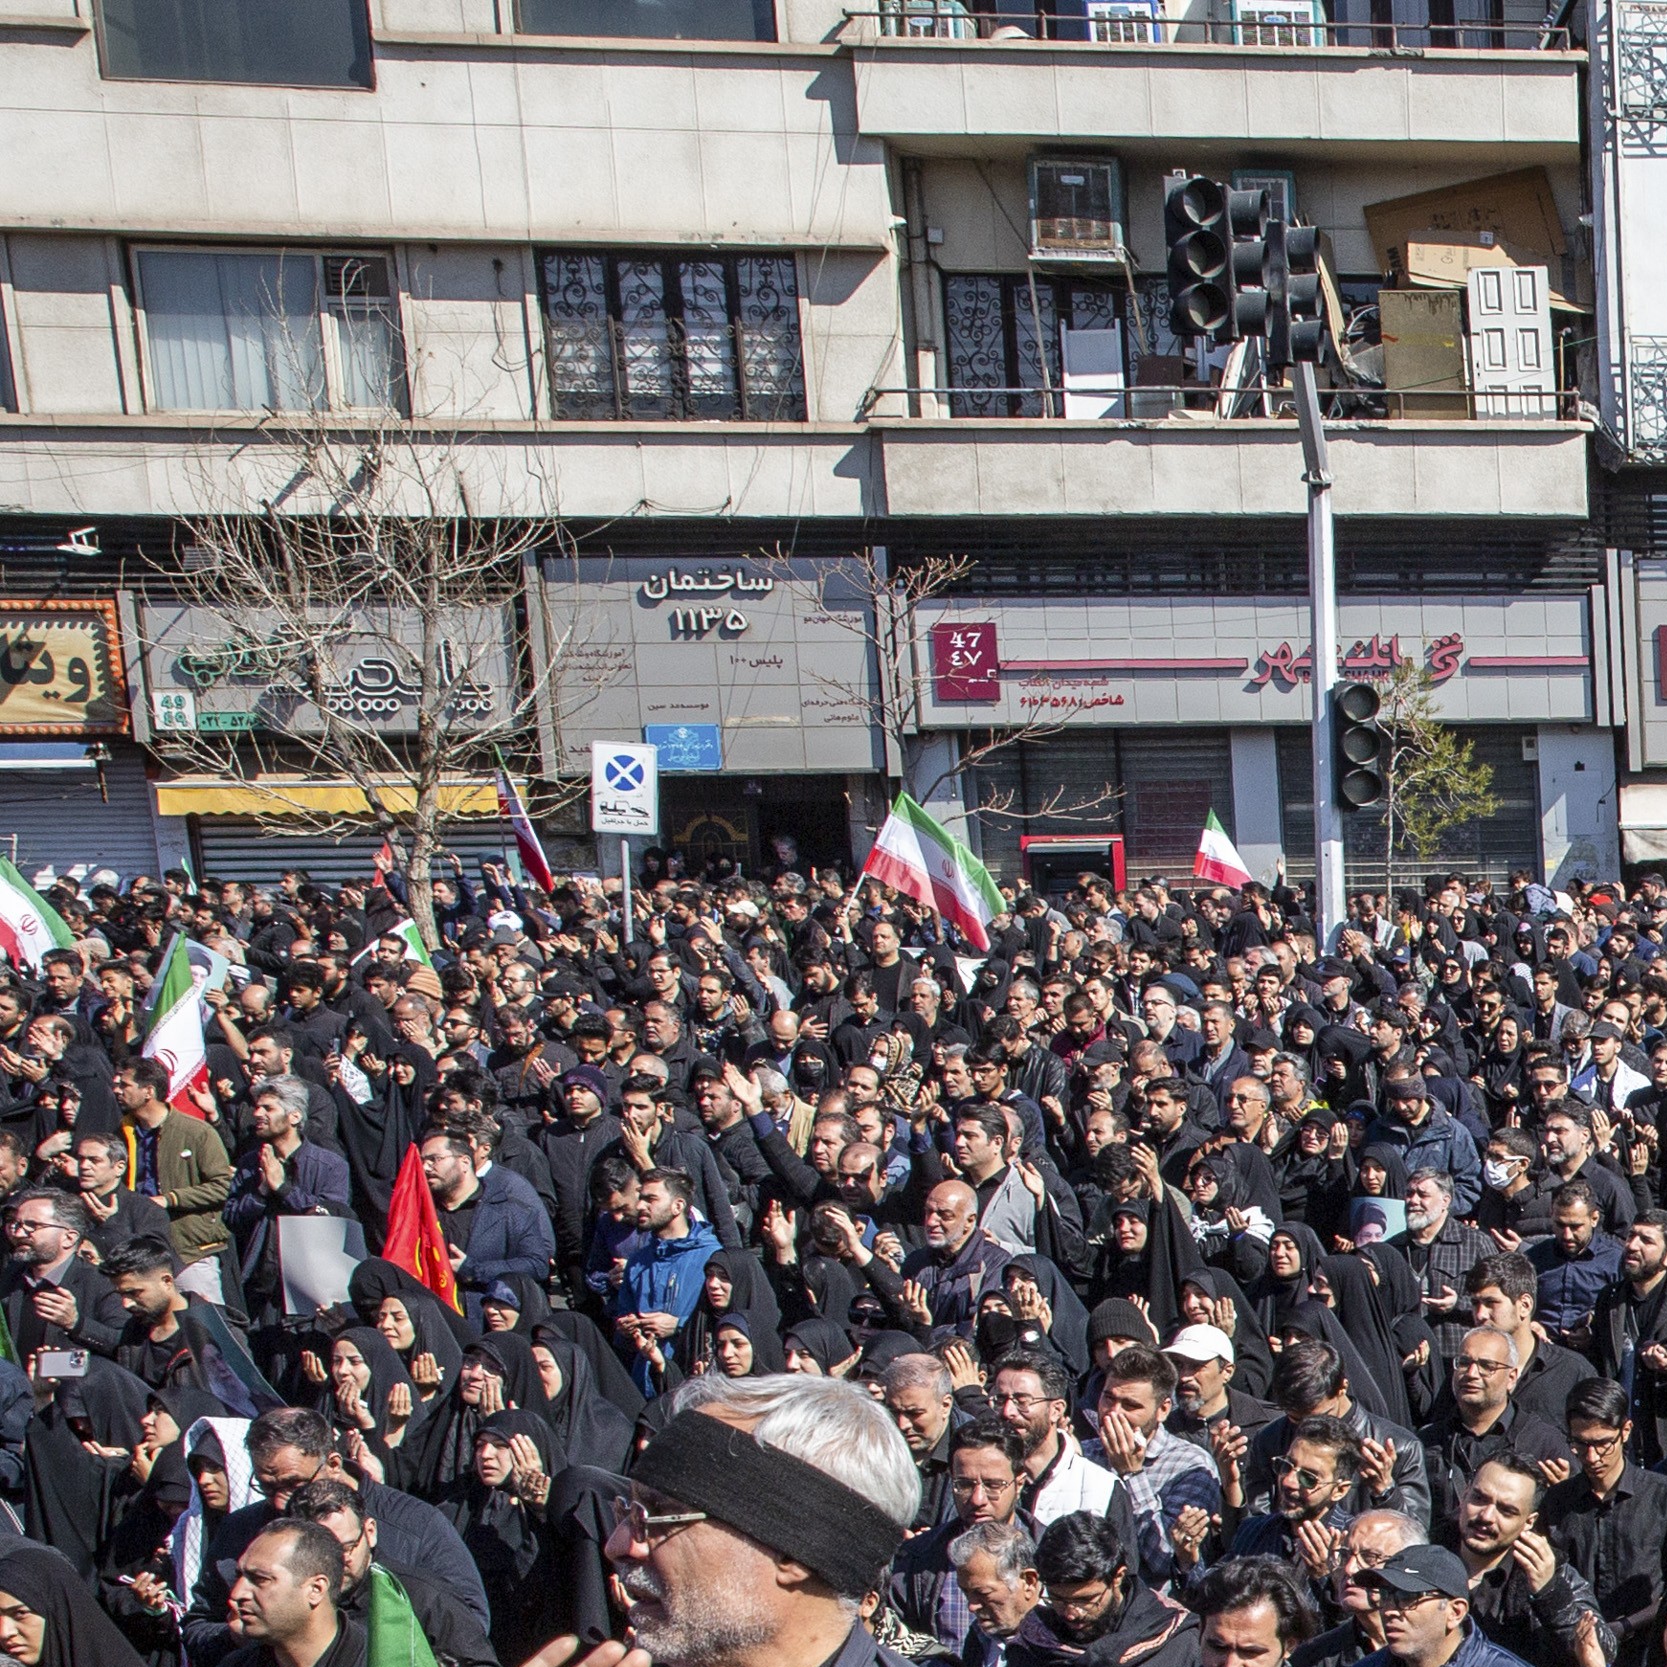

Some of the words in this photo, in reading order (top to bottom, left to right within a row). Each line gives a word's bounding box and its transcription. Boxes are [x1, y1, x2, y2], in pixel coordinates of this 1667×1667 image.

[643, 565, 774, 599] ساختمان
[674, 607, 749, 631] ۱۱۳۵
[949, 632, 982, 648] 47
[749, 655, 784, 669] پلیس
[160, 694, 188, 710] 49
